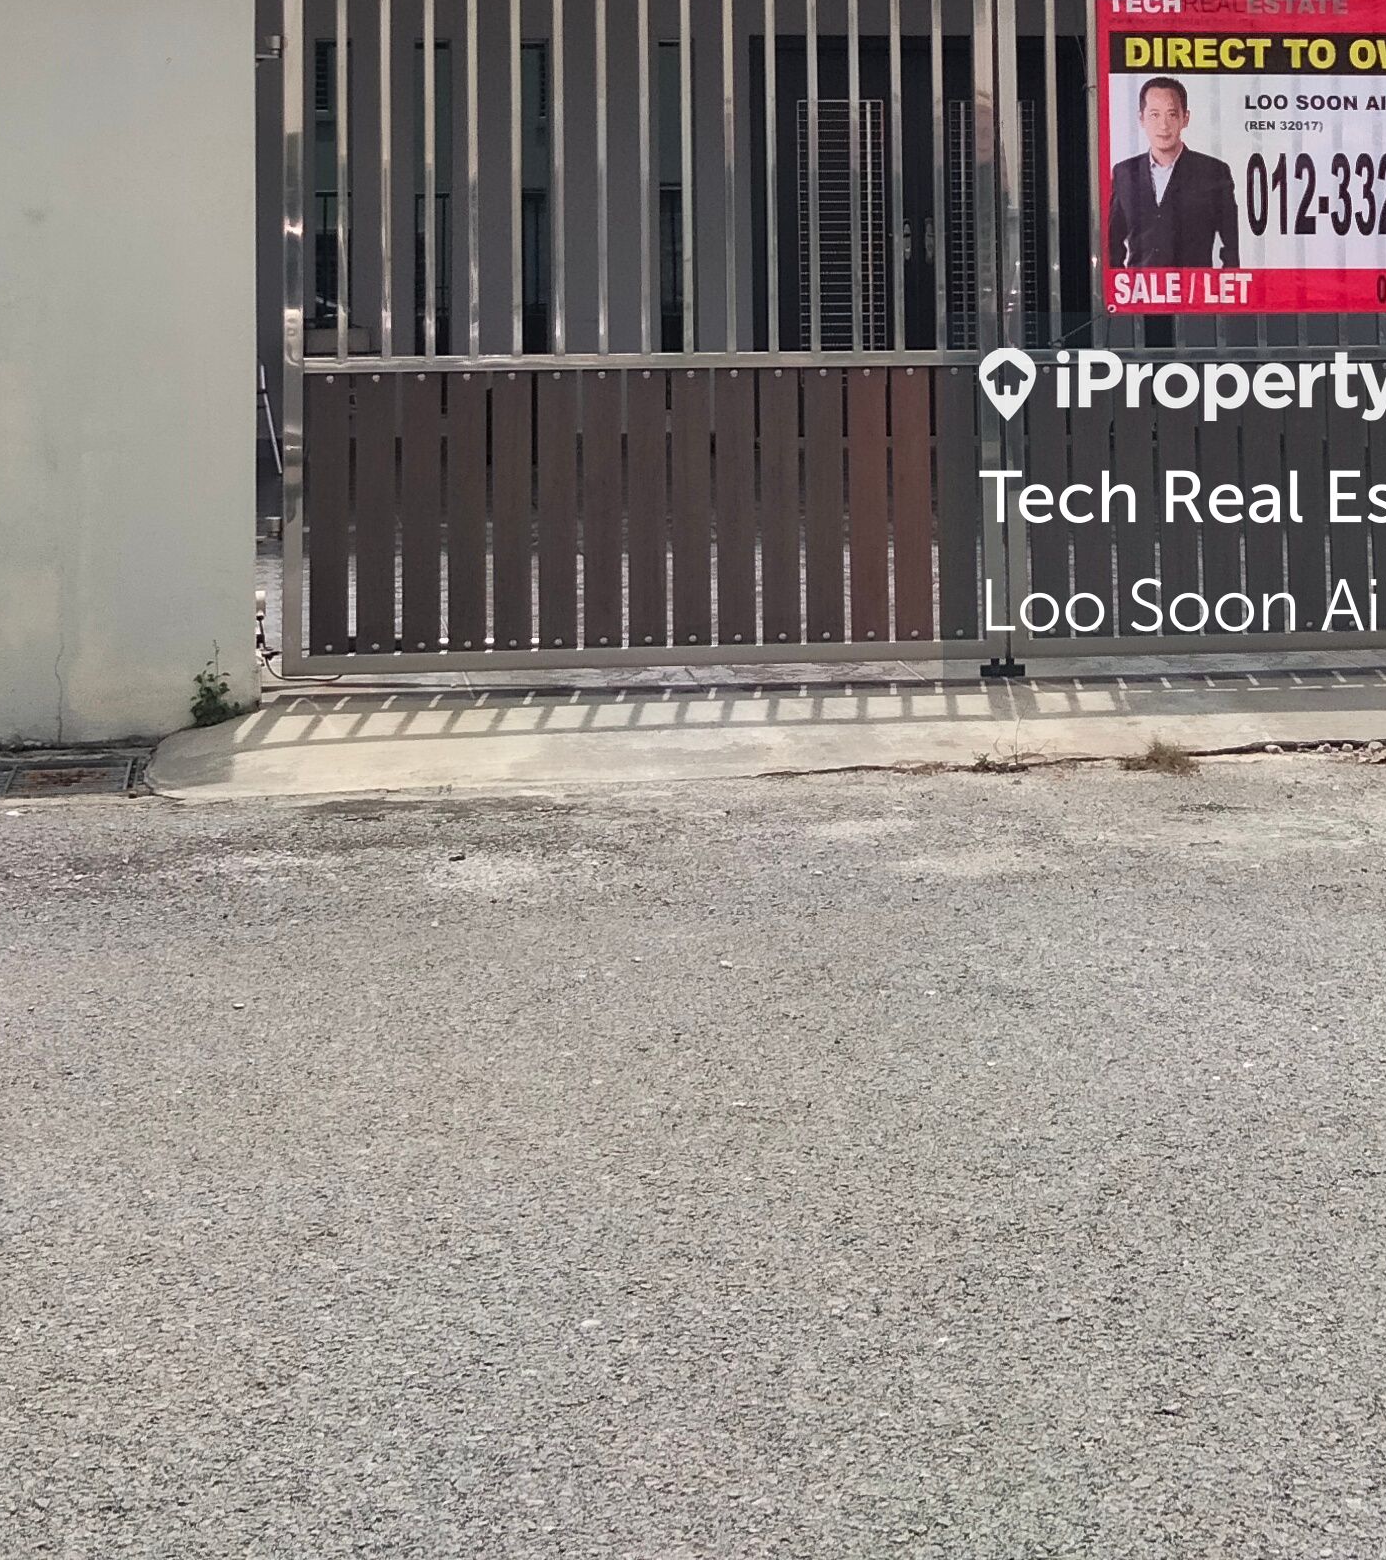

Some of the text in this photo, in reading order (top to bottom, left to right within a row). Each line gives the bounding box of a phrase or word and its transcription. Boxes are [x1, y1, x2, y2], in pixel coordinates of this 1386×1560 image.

[1125, 38, 1271, 69] DIRECT
[1282, 39, 1336, 69] TO
[1244, 94, 1288, 111] LOO
[1296, 95, 1358, 111] SOON
[1244, 120, 1323, 132] (REN 32017)
[1114, 273, 1253, 305] SALE / LET
